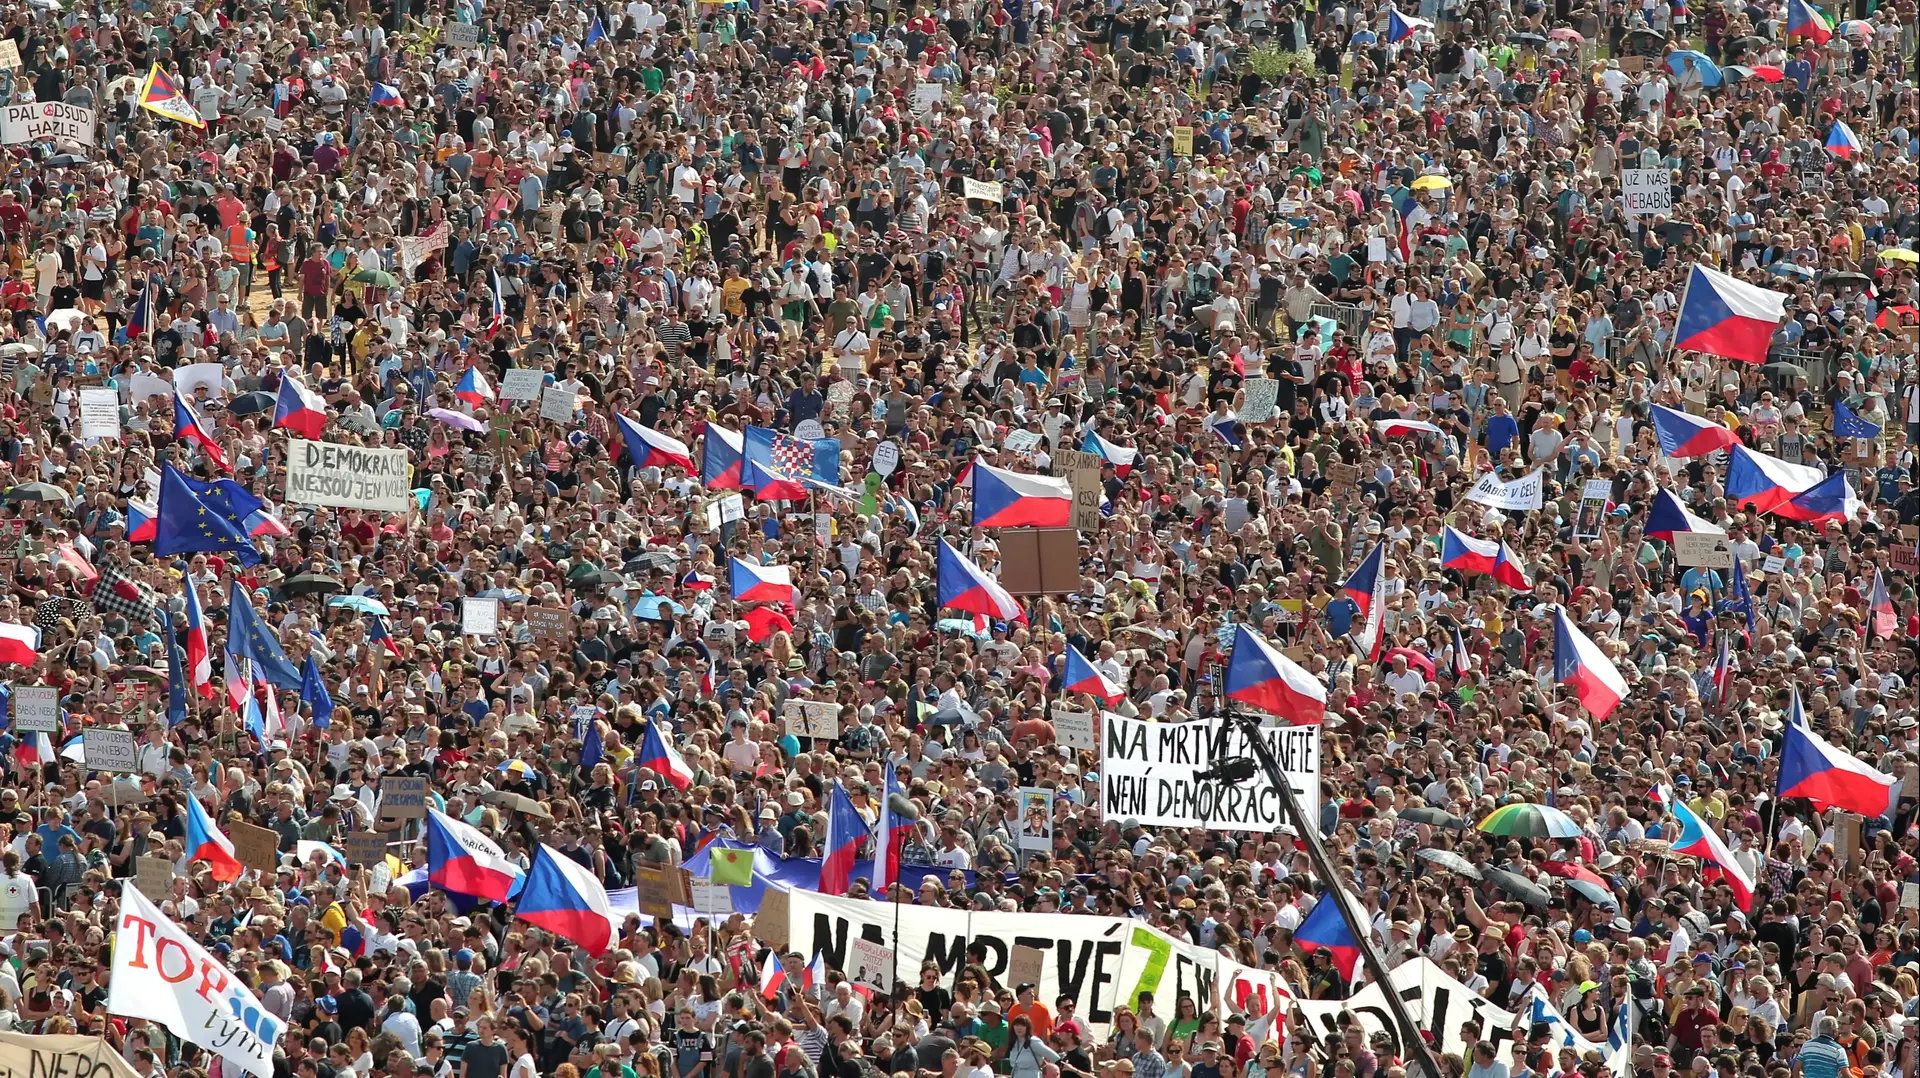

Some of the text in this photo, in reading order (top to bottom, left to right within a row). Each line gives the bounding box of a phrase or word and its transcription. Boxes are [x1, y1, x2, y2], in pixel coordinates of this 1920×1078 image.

[8, 106, 39, 122] PAL
[1625, 170, 1668, 186] UŽ NÁS
[1624, 186, 1670, 209] NEBABIŠ
[306, 442, 404, 476] DEMOKRACIE
[878, 445, 898, 459] EET
[292, 472, 352, 498] NEJSOU
[354, 481, 381, 500] JEN
[1478, 480, 1508, 497] BABIŠ
[1510, 488, 1518, 498] V
[38, 706, 56, 717] NEBO
[16, 718, 54, 728] BUDOUCNOST
[1108, 718, 1148, 762] NA
[1107, 766, 1152, 816] NENÍ
[123, 914, 228, 1004] TOP
